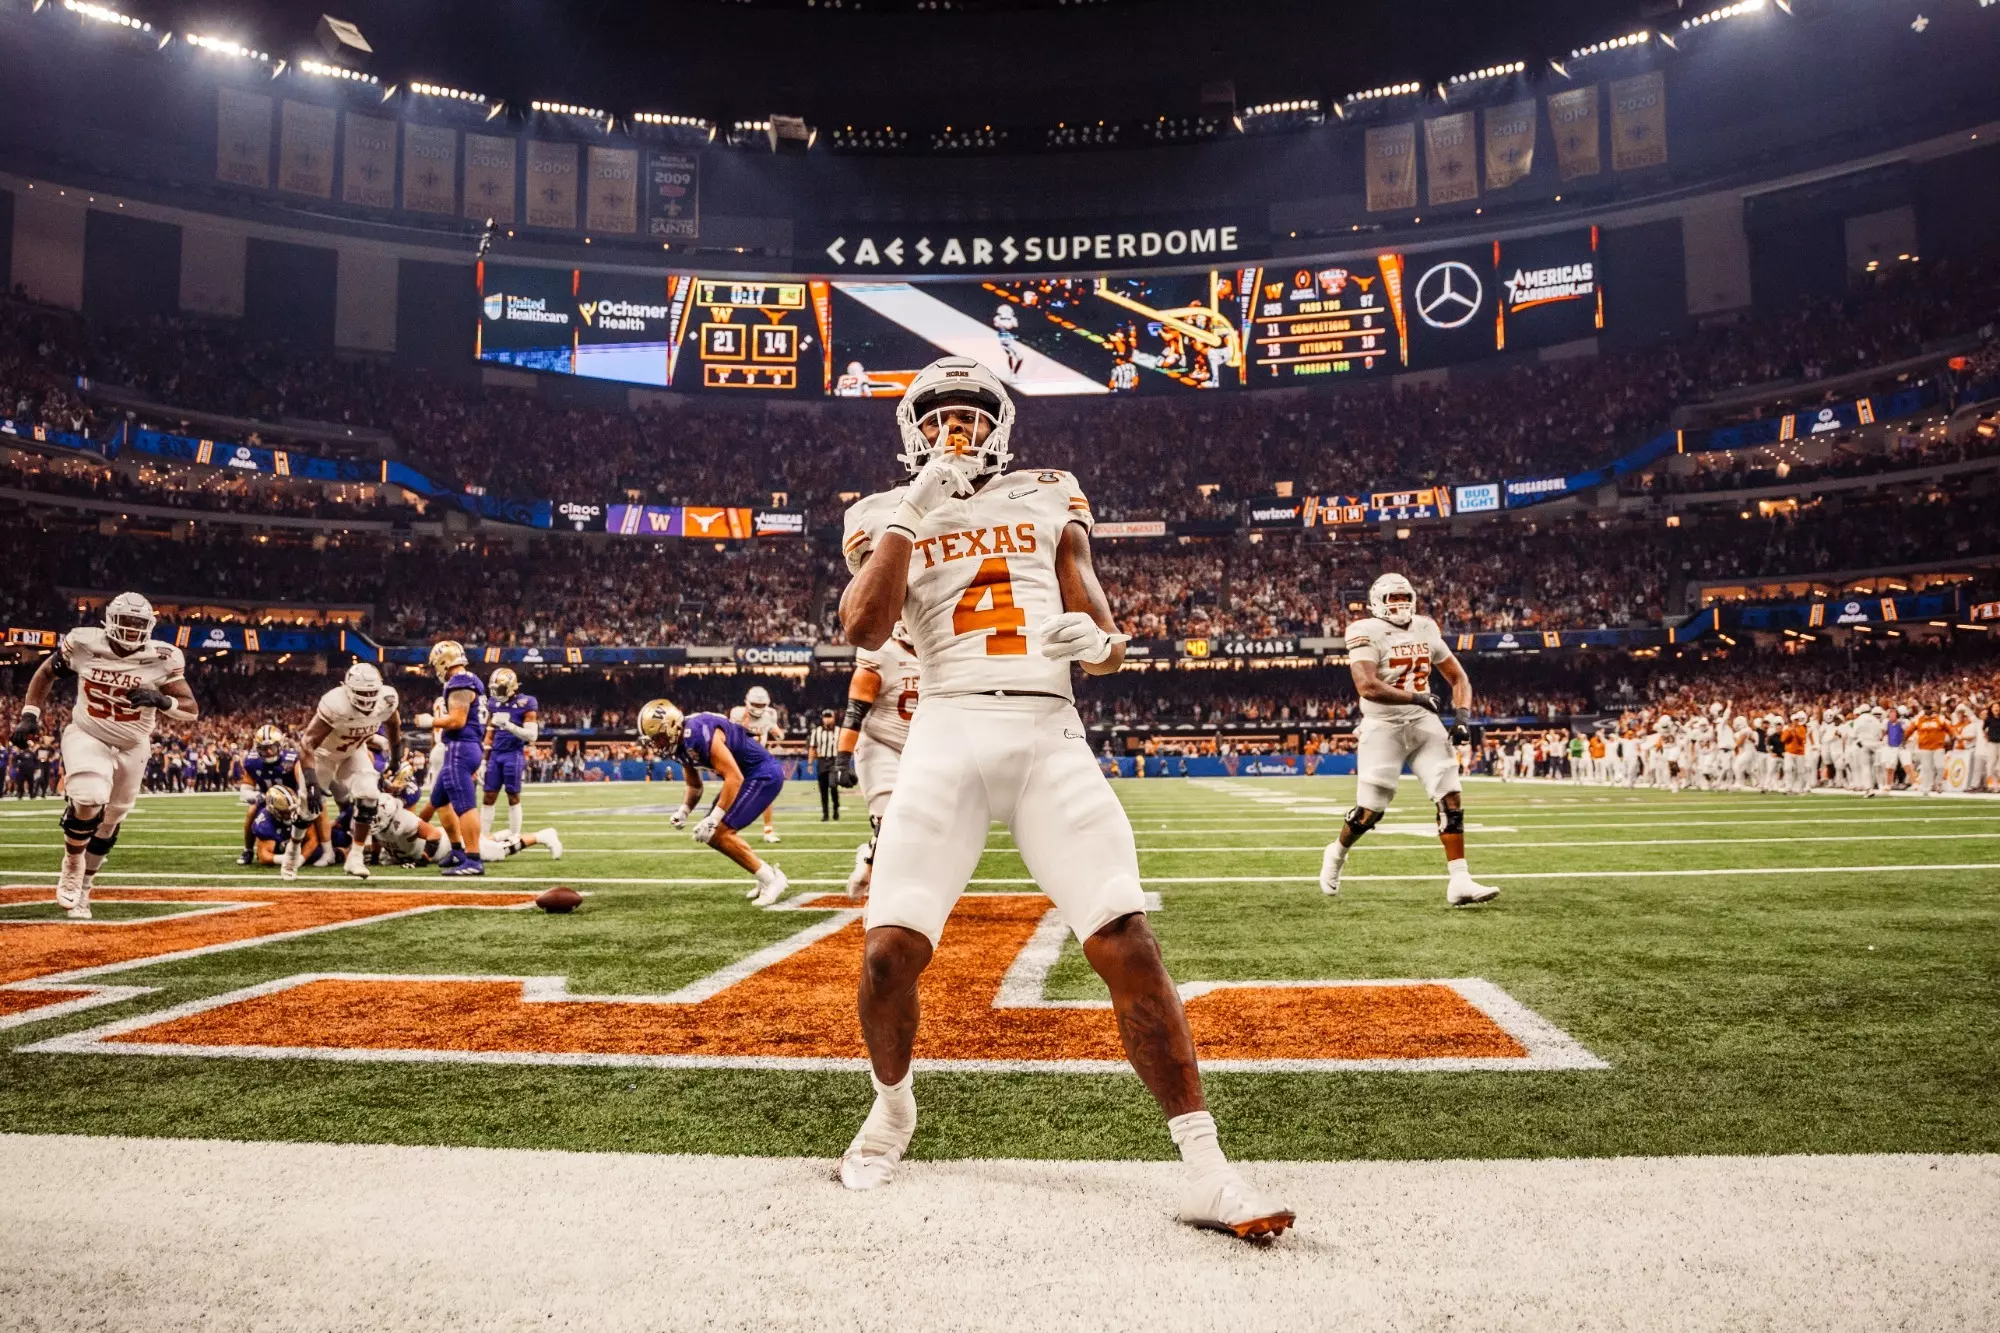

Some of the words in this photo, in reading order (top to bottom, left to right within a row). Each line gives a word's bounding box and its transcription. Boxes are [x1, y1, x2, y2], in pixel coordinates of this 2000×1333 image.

[655, 172, 691, 185] 2009
[651, 222, 695, 234] SAINTS
[826, 236, 1020, 266] CAESARS
[1024, 226, 1239, 262] SUPERDOME
[1504, 262, 1594, 290] AMERICAS
[730, 285, 766, 304] 0:17
[507, 295, 546, 311] United
[598, 299, 668, 319] Ochsner
[507, 309, 568, 324] Healthcare
[599, 316, 645, 331] Health
[1268, 323, 1280, 336] 11
[713, 330, 735, 352] 21
[764, 332, 787, 354] 14
[1464, 489, 1490, 499] BUD
[1460, 497, 1495, 509] LIGHT
[648, 512, 671, 532] W
[1252, 508, 1296, 521] verizon
[914, 523, 1037, 569] TEXAS
[952, 557, 1027, 655] 4
[1186, 640, 1207, 656] 40
[1225, 641, 1294, 654] CAESARS
[1391, 642, 1430, 657] TEXAS
[745, 648, 813, 664] Ochsner
[91, 668, 142, 689] TEXAS
